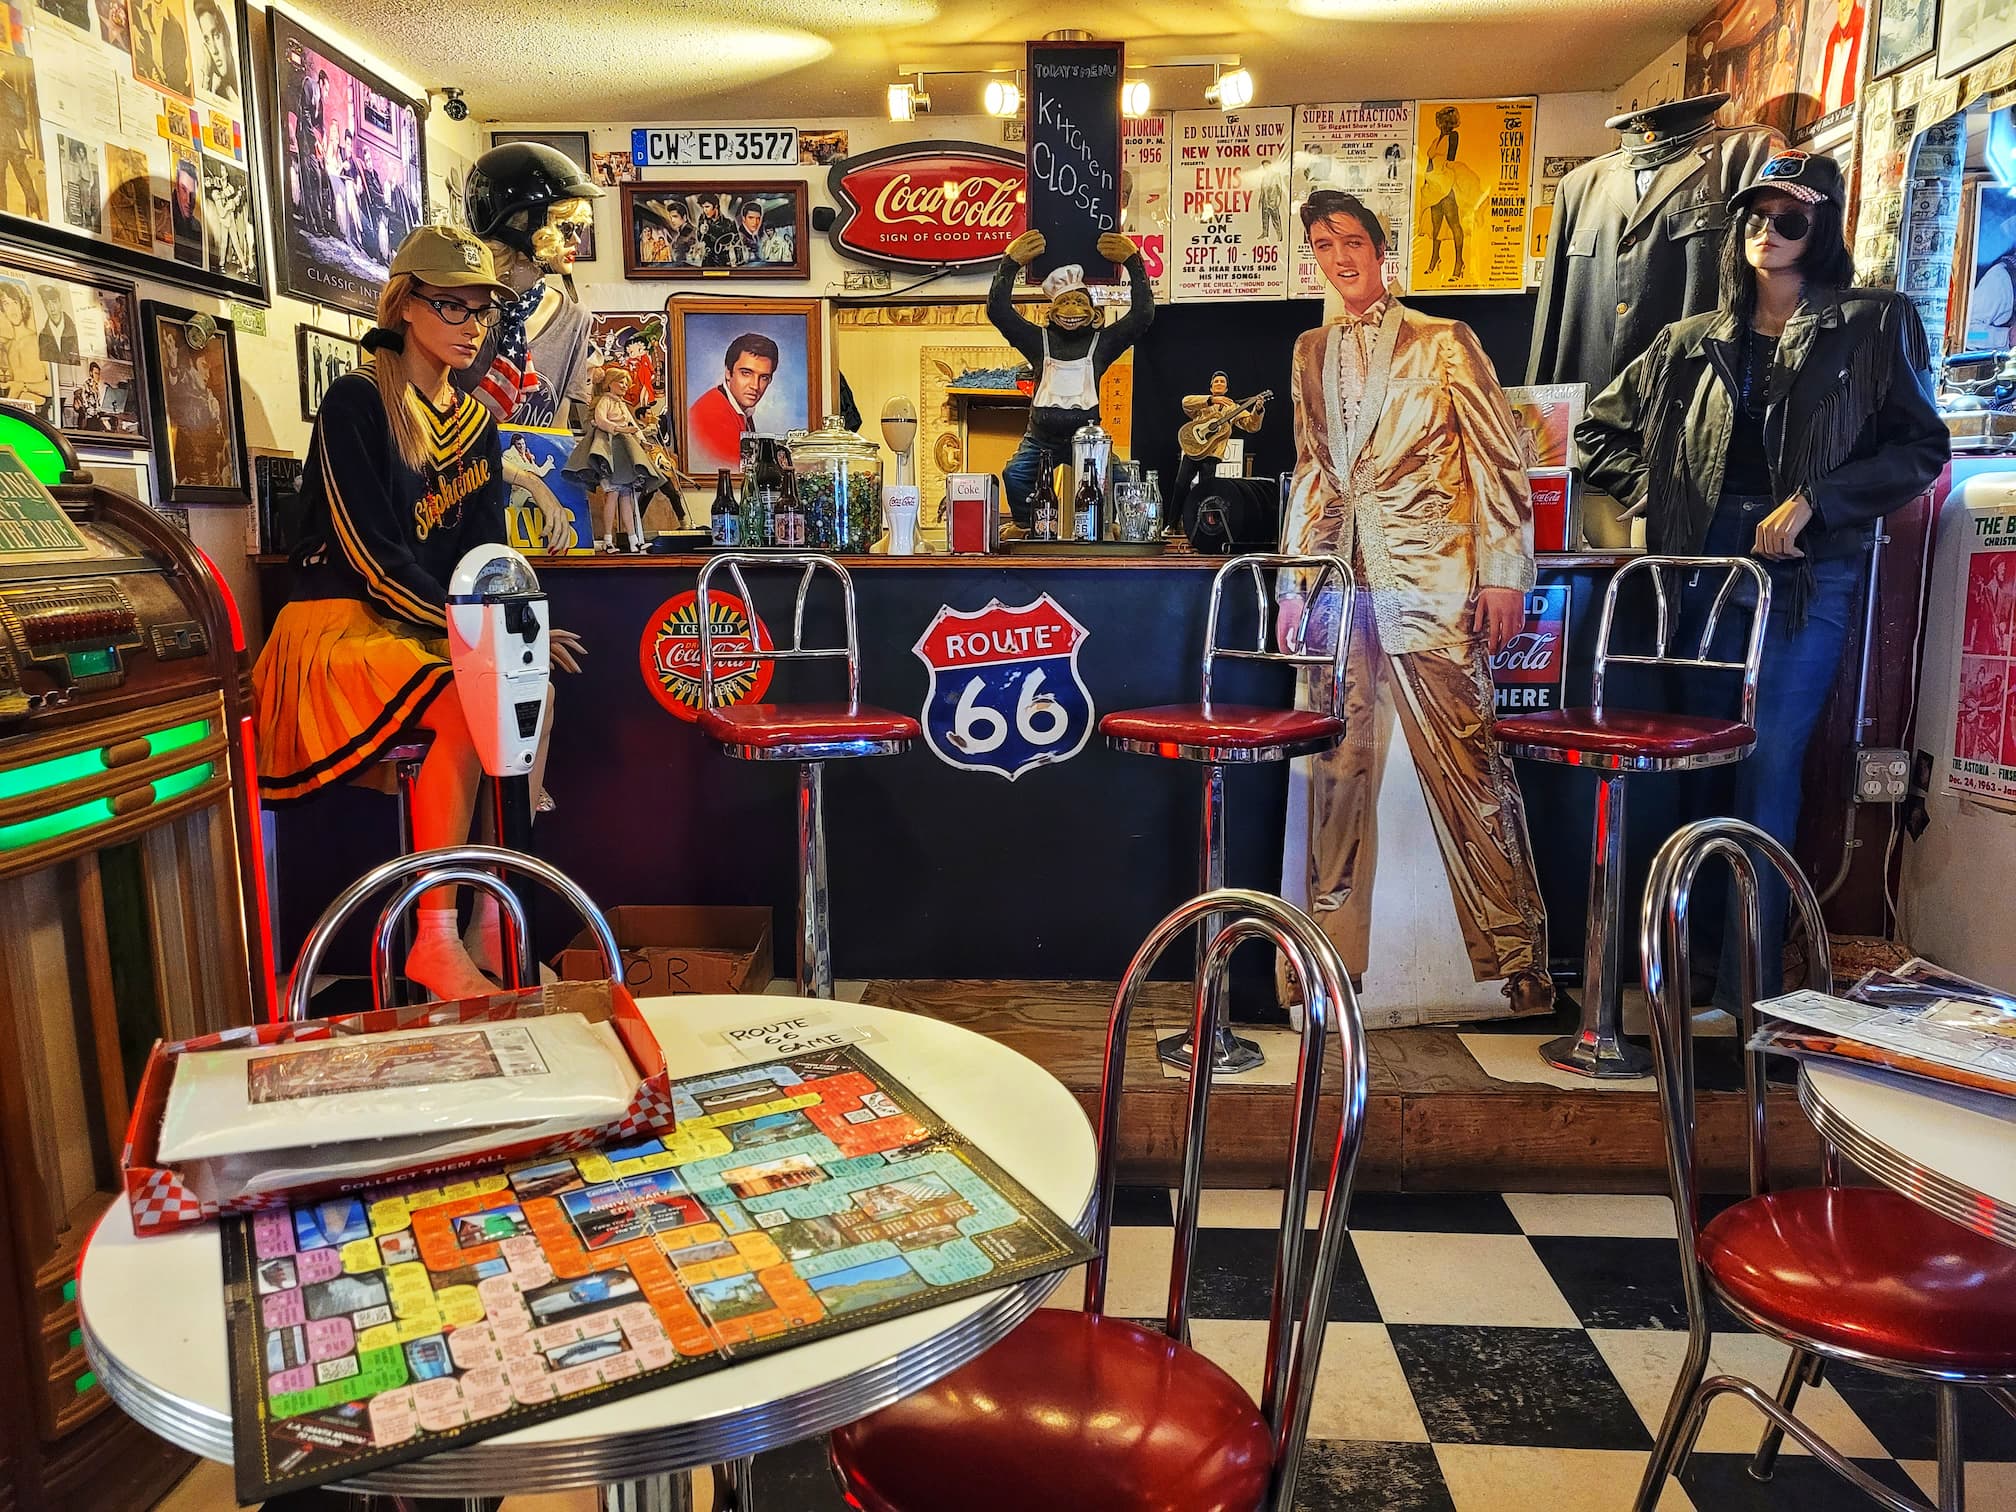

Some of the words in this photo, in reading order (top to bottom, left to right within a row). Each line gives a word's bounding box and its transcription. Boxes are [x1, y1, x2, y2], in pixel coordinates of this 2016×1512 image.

[1035, 64, 1079, 79] TODAY'S
[1080, 64, 1116, 78] MENU
[1303, 111, 1334, 123] SUPER
[1340, 109, 1408, 122] ATTRACTIONS
[1184, 126, 1197, 139] ED
[1202, 125, 1250, 139] SULLIVAN
[1255, 123, 1285, 137] SHOW
[637, 152, 644, 160] D
[650, 133, 679, 160] CW
[699, 133, 728, 160] EP
[735, 133, 793, 160] 3577
[1038, 91, 1113, 190] Kitchen
[1499, 132, 1524, 147] SEVEN
[1139, 147, 1162, 164] 1956
[1182, 146, 1210, 159] NEW
[1216, 145, 1250, 158] YORK
[1256, 143, 1285, 157] CITY
[1500, 148, 1521, 163] YEAR
[1196, 167, 1242, 190] ELVIS
[1501, 165, 1519, 180] ITCH
[1033, 142, 1114, 231] CLOSED
[874, 174, 1024, 227] CocaCola
[1184, 190, 1253, 214] PRESLEY
[1491, 198, 1525, 206] MARILYN
[1491, 208, 1524, 217] MONROE
[1207, 225, 1227, 233] ON
[1507, 224, 1522, 232] Ewell
[880, 233, 908, 242] SIGN
[913, 233, 929, 241] OF
[934, 232, 970, 241] GOOD
[976, 231, 1012, 240] TASTE
[1191, 235, 1242, 244] STAGE
[1185, 247, 1220, 264] SEPT.
[1227, 246, 1237, 264] 10
[1252, 245, 1278, 263] 1956
[307, 267, 356, 293] CLASSIC
[360, 286, 382, 300] INT
[957, 484, 980, 495] Coke
[1974, 516, 2004, 535] THE
[680, 625, 698, 634] ICE
[711, 624, 734, 635] OLD
[946, 625, 1053, 660] ROUTE
[676, 681, 701, 697] SOL
[1495, 688, 1550, 707] HERE
[950, 667, 1069, 755] 66
[1952, 759, 1962, 771] THE
[1964, 761, 1989, 776] ASTORIA
[1949, 774, 1962, 785] Dec.
[729, 1018, 809, 1041] ROUTE
[764, 1031, 799, 1044] 66
[778, 1034, 843, 1054] GAME
[340, 1171, 420, 1193] COLLECT
[423, 1161, 471, 1175] THEM
[476, 1154, 507, 1166] ALL
[588, 1189, 669, 1214] ANNIVSARY
